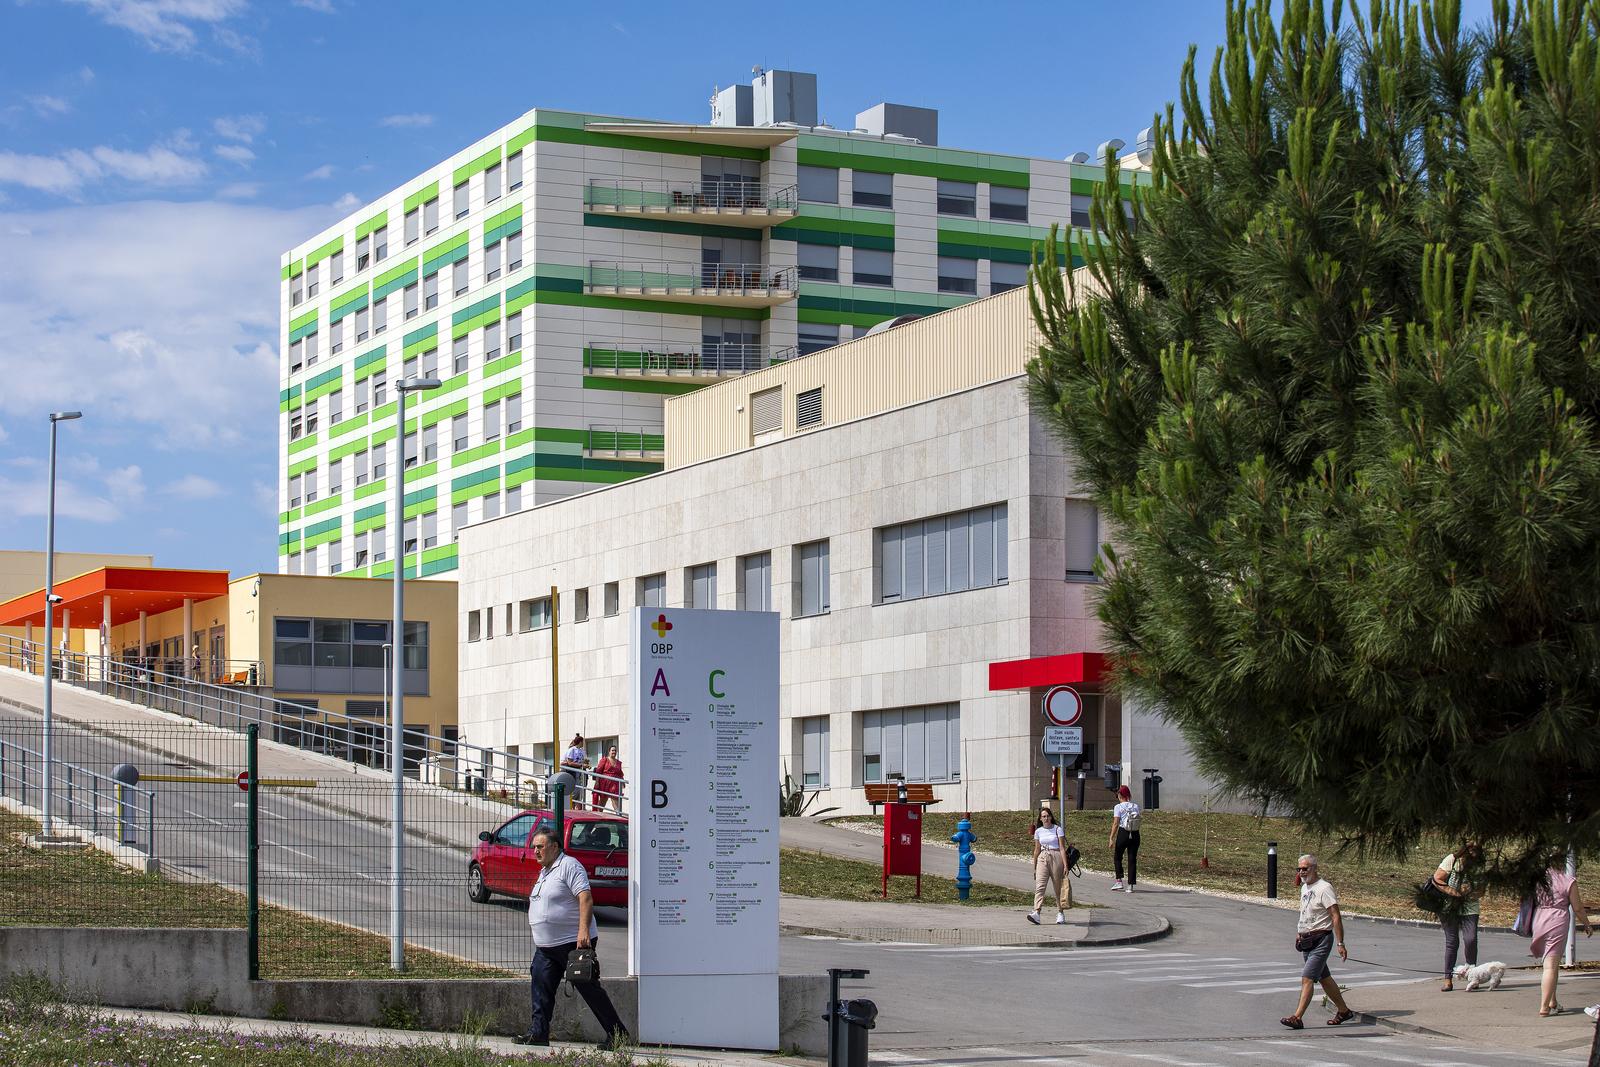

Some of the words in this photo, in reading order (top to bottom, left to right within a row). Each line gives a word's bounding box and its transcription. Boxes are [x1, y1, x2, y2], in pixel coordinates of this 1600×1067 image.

[651, 643, 673, 654] OBP
[650, 667, 670, 697] A
[709, 669, 726, 698] C
[650, 702, 656, 711] 0
[708, 703, 714, 712] 0
[710, 720, 714, 729] 1
[652, 728, 656, 736] 1
[708, 764, 715, 774] 2
[708, 782, 714, 791] 3
[651, 779, 668, 809] B
[708, 805, 714, 814] 4
[708, 828, 714, 837] 5
[650, 839, 657, 849] 0
[708, 860, 714, 870] 6
[708, 893, 714, 902] 7
[652, 900, 656, 908] 1
